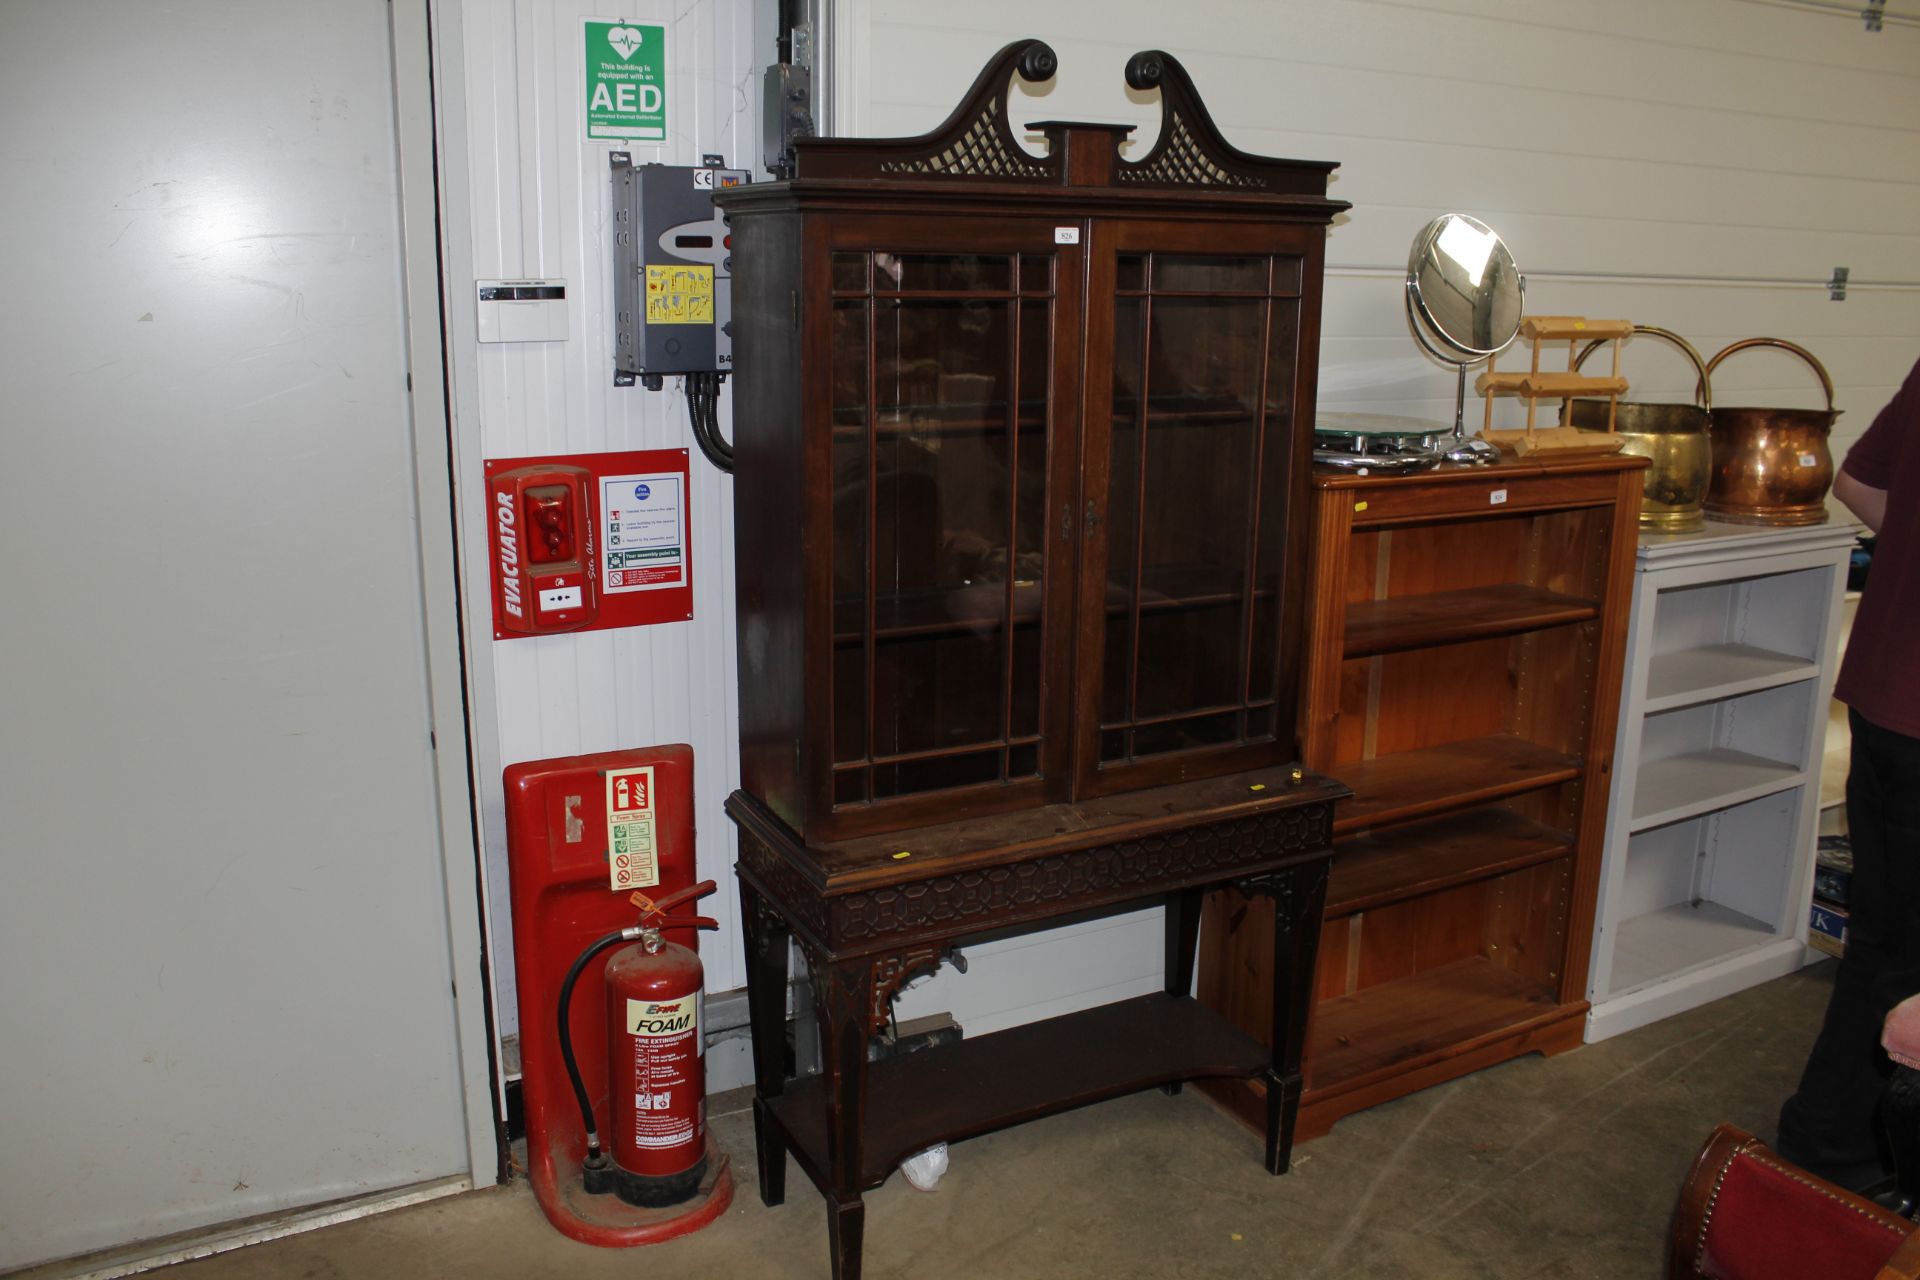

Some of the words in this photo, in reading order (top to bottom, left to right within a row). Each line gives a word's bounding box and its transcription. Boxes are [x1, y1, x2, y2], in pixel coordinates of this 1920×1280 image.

[616, 64, 642, 72] building
[590, 82, 662, 113] AED
[695, 172, 711, 185] CE
[497, 492, 522, 618] EVACUATOR
[588, 560, 597, 580] Site
[636, 1014, 690, 1033] FOAM
[651, 1031, 693, 1044] EXTINGUISHER
